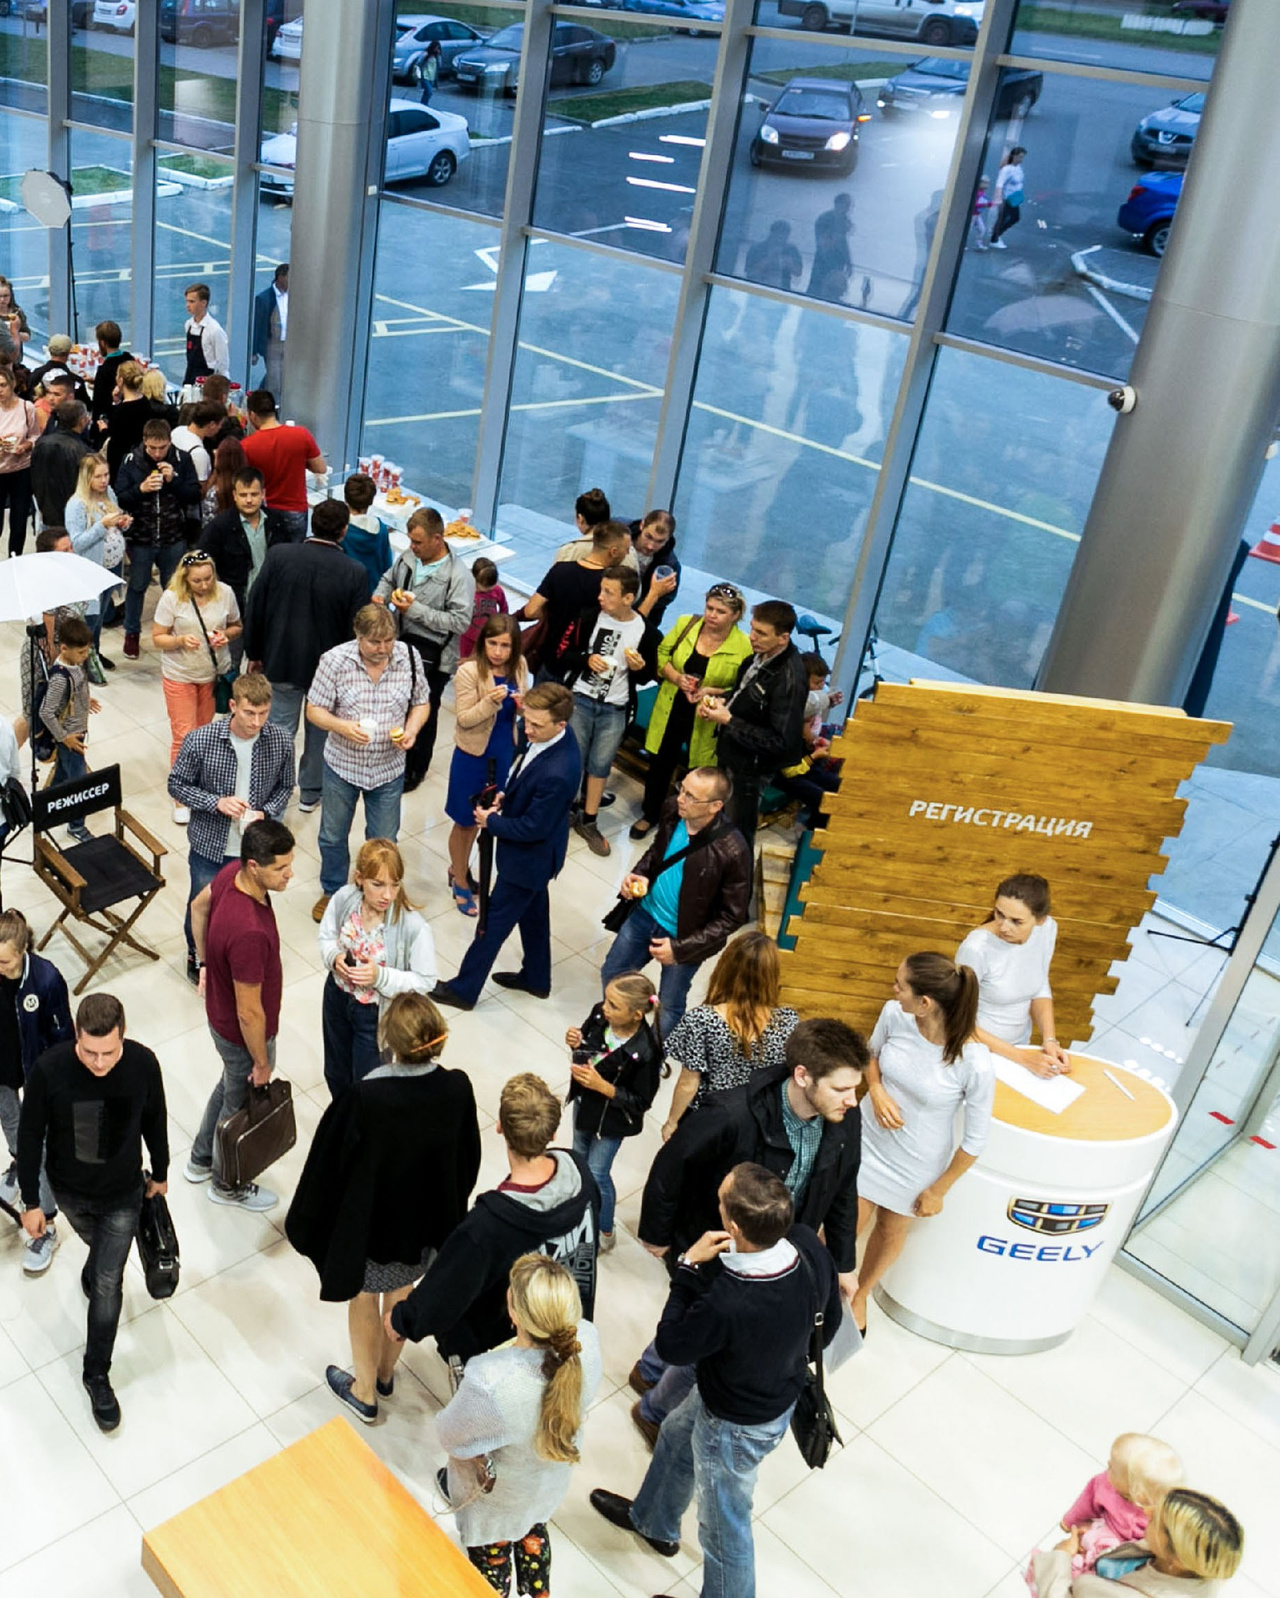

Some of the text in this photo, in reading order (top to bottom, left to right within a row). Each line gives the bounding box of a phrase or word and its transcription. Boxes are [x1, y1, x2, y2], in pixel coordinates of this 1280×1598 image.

[47, 782, 109, 813] РЕЖИССЕР
[908, 799, 1094, 838] РЕГИСТРАЦИЯ
[976, 1235, 1105, 1262] GEELY
